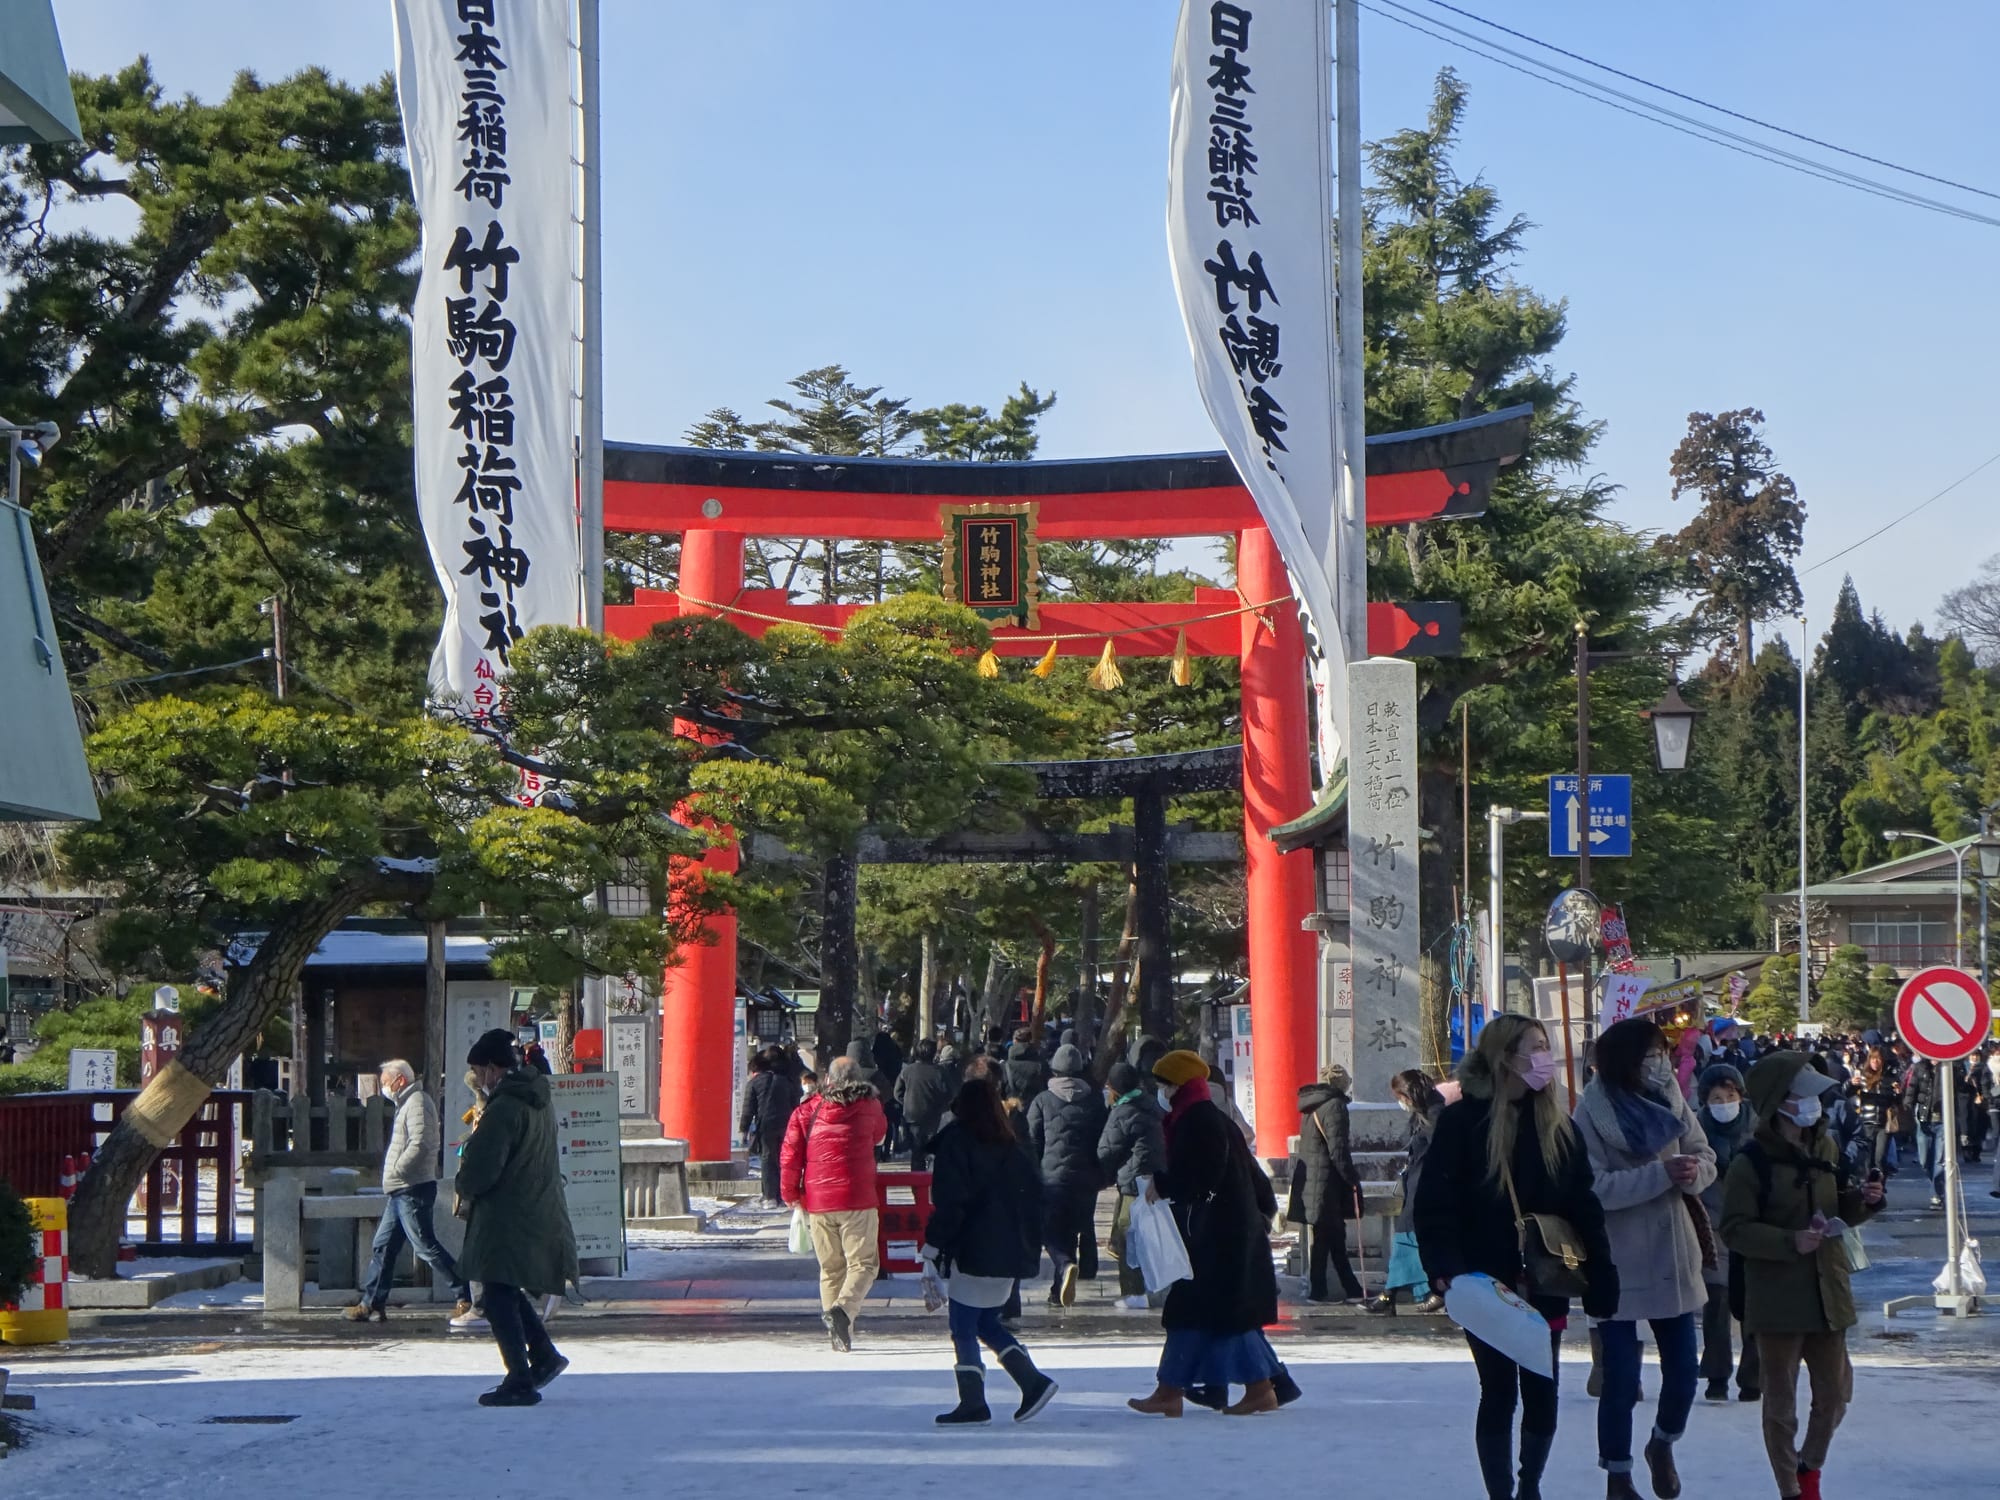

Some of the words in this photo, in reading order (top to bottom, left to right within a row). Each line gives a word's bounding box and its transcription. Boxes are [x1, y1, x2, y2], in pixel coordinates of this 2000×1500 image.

[980, 526, 1001, 599] 竹駒神社
[1554, 780, 1602, 792] 車お所
[1590, 815, 1626, 827] 駐車場
[1362, 833, 1407, 1051] 竹駒神社
